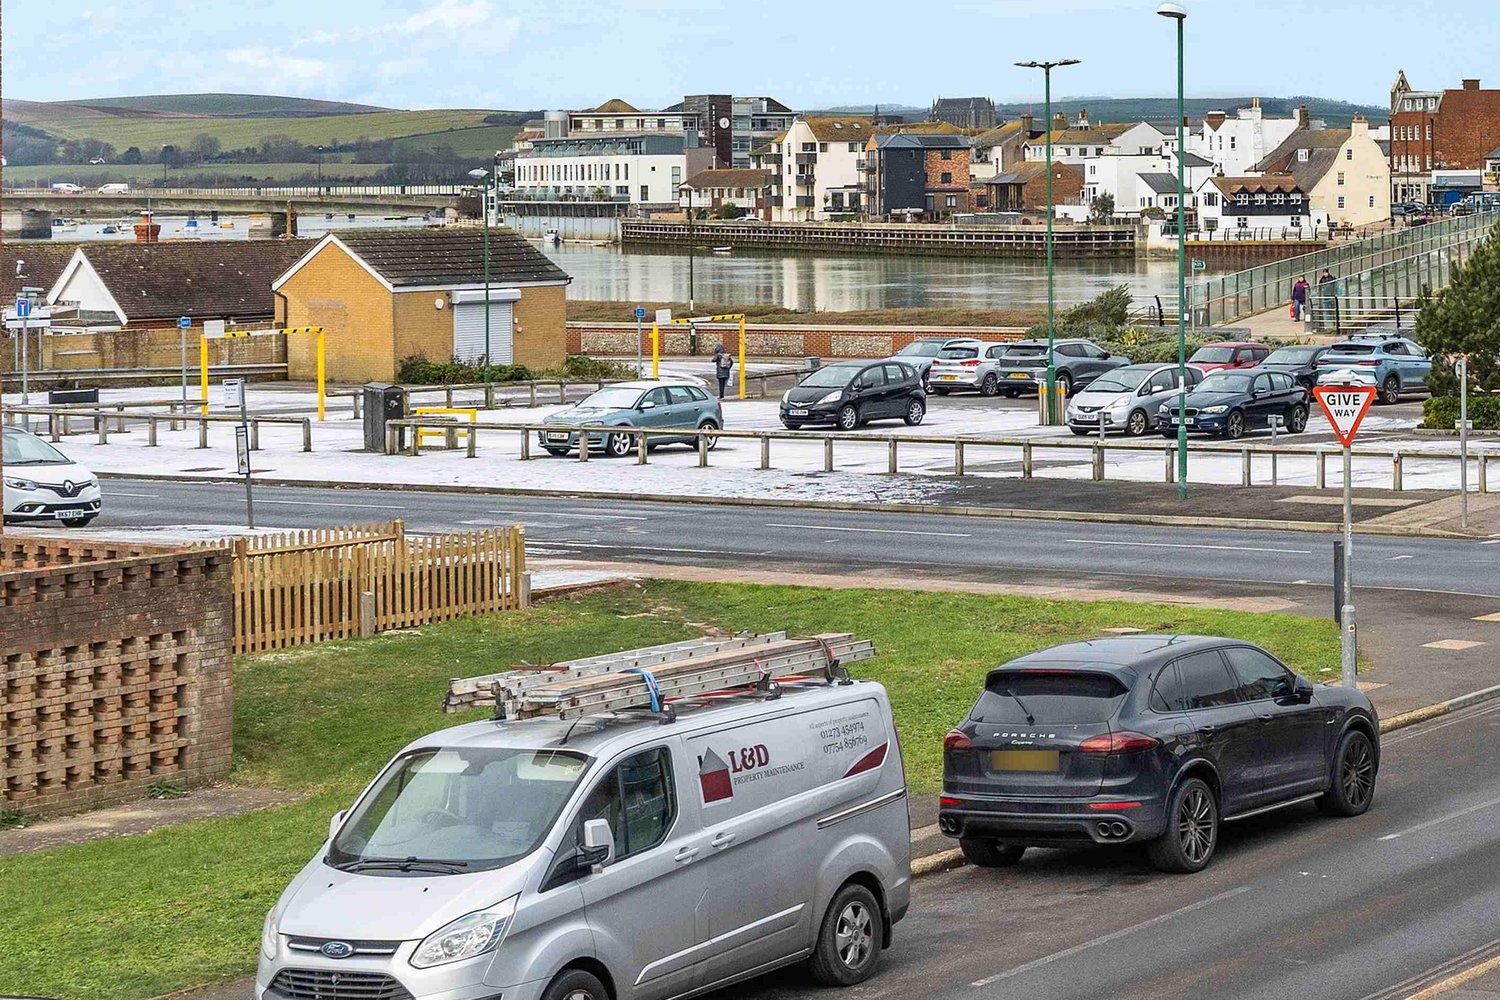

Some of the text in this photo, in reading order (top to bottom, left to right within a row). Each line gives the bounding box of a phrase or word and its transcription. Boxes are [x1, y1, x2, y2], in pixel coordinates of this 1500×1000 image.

[1326, 393, 1361, 406] GIVE
[1334, 408, 1356, 417] WAY
[820, 721, 865, 739] 01273 454974
[823, 734, 868, 755] 07754 856769
[727, 743, 770, 773] L&D
[733, 761, 805, 786] PROPERTY MAINTENANCE
[327, 943, 345, 953] Ford
